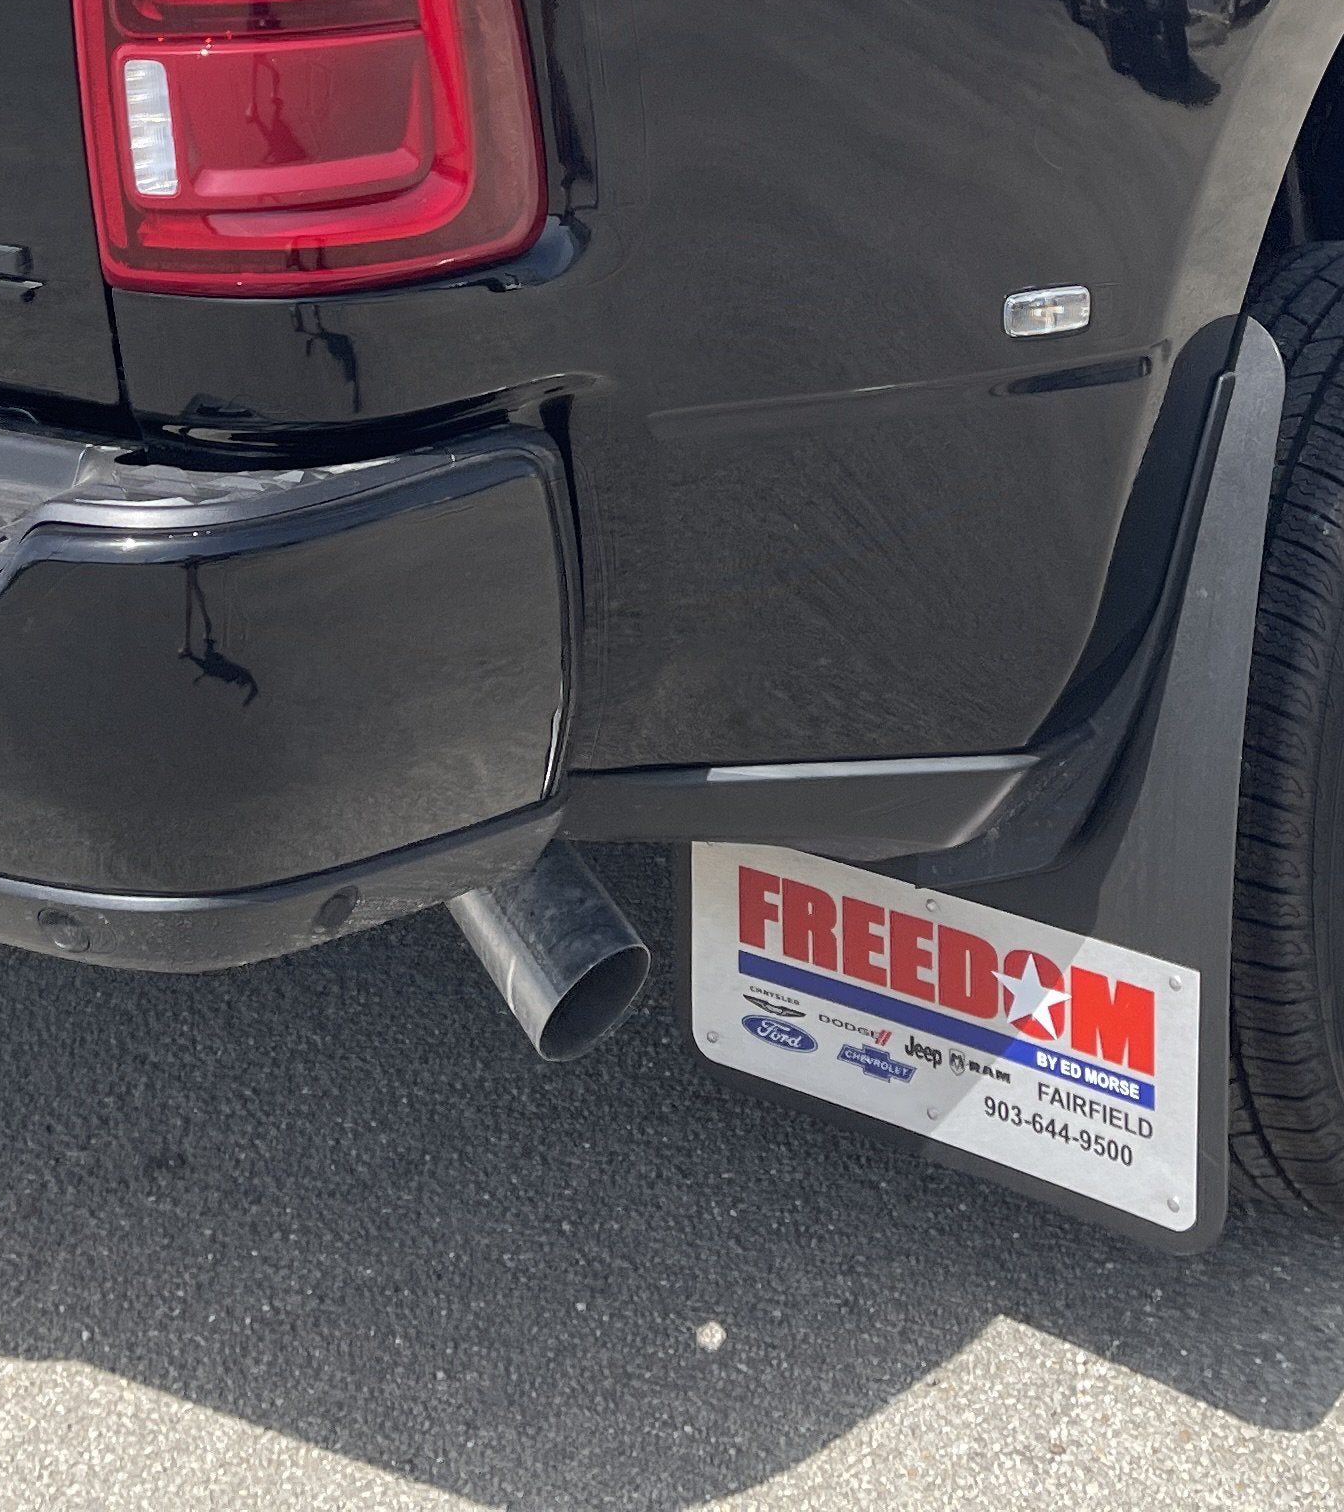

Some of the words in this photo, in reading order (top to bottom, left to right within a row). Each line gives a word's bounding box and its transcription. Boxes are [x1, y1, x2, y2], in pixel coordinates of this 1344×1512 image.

[738, 865, 1156, 1077] FREEDOM
[749, 985, 800, 1006] CHRYSLER
[757, 1018, 801, 1049] Ford
[843, 1048, 910, 1078] CHEVROLET
[905, 1035, 943, 1068] Jeep
[968, 1060, 1012, 1084] RAM
[1036, 1051, 1057, 1071] BY
[1060, 1059, 1082, 1079] ED
[1084, 1067, 1141, 1100] MORSE
[983, 1095, 1134, 1167] 903-644-9500
[1037, 1081, 1154, 1139] FAIRFIELD
